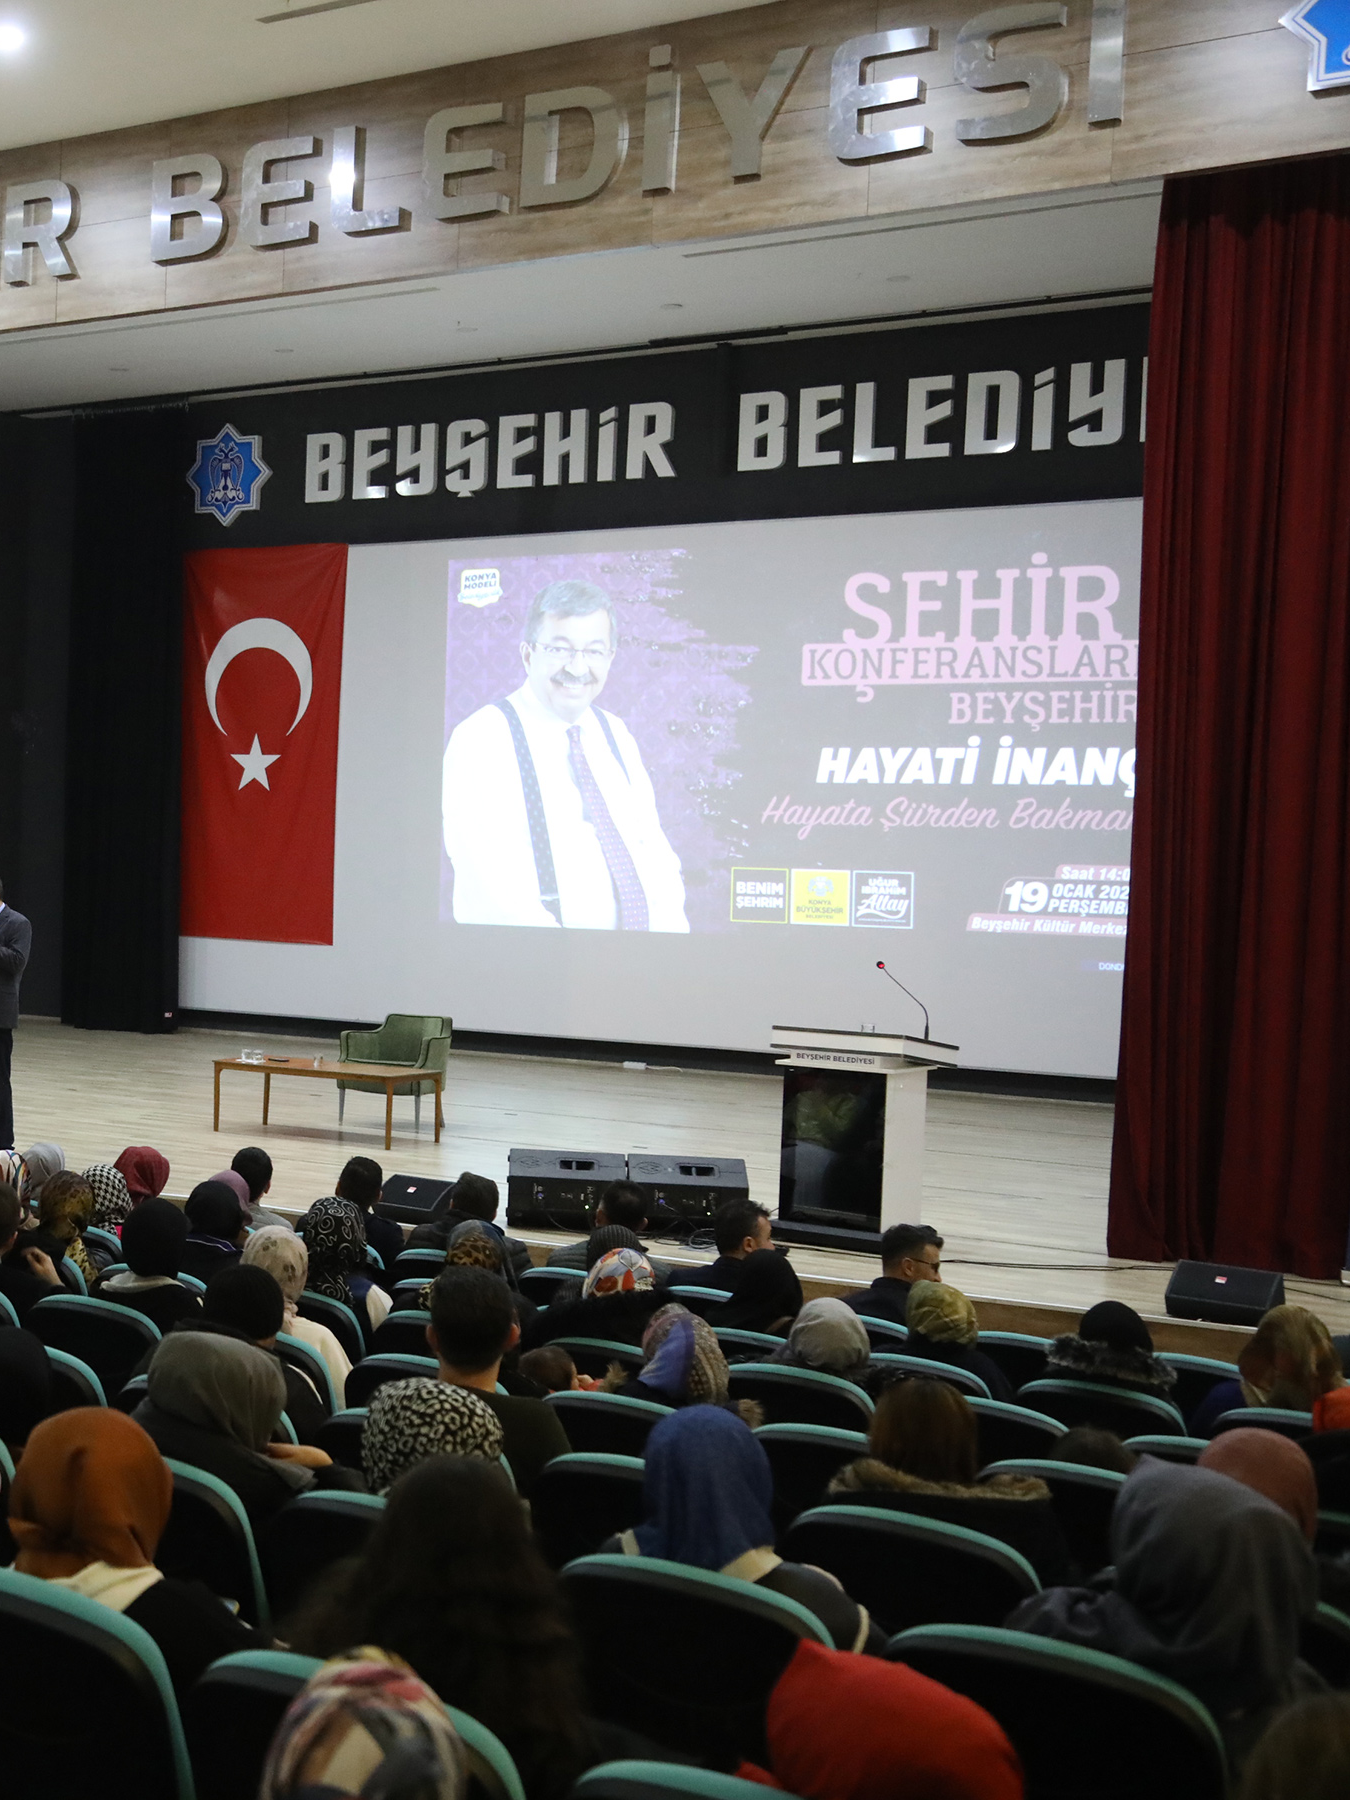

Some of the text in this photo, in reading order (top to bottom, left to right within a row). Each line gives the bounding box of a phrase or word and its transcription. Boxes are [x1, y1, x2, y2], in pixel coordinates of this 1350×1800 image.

[304, 356, 1148, 504] BEYŞEHİR BELEDİY
[464, 572, 497, 582] KONYA
[948, 682, 1137, 732] BEYŞEHİR
[815, 735, 982, 785] HAYATİ
[761, 794, 873, 840] Hayata
[1061, 866, 1095, 881] Saat
[1004, 880, 1049, 914] 19
[1052, 883, 1097, 899] OCAK
[971, 917, 1031, 933] Beyşehir
[1033, 918, 1076, 933] Kültür
[1098, 962, 1125, 972] DOND
[796, 1052, 875, 1065] BEYŞEHİR BELEDİYESİ
